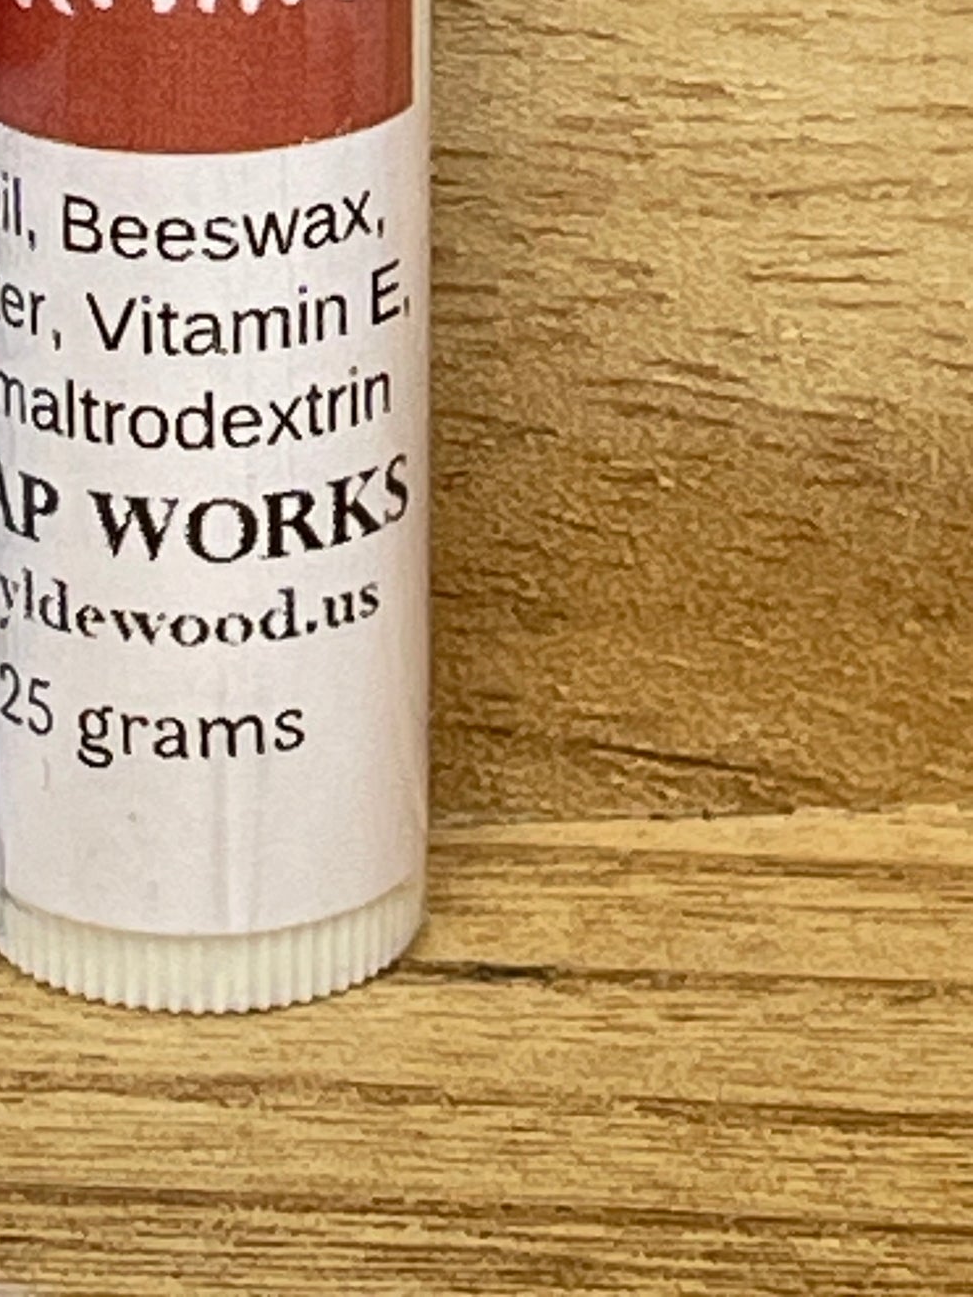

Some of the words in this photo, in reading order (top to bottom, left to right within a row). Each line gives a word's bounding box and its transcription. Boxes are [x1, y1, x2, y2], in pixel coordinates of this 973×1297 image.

[63, 190, 384, 261] Beeswax,
[86, 285, 347, 356] Vitamin
[371, 258, 410, 326] E,
[87, 453, 409, 563] WORKS
[77, 705, 305, 768] grams
